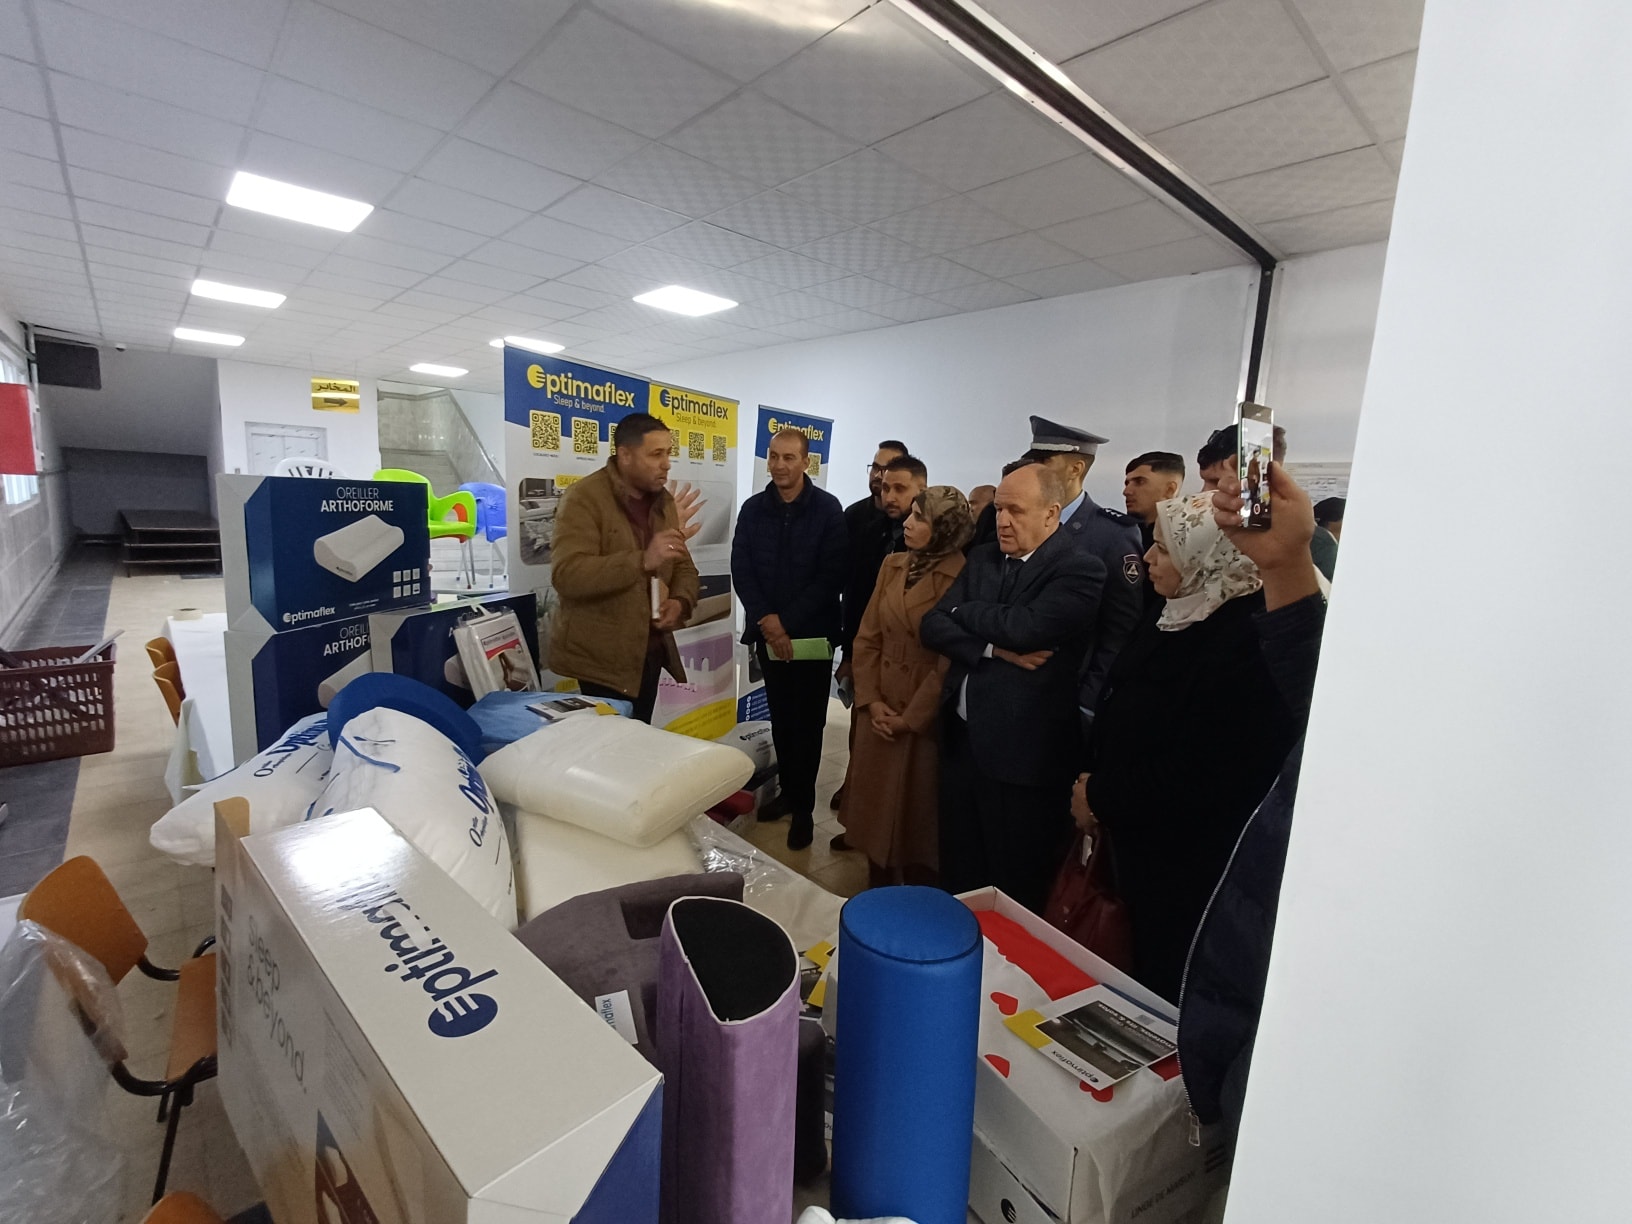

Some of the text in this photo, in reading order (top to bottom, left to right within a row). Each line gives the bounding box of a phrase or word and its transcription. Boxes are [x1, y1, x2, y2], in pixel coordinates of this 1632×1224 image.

[527, 364, 635, 408] Optimaflex
[554, 394, 573, 408] Sleep
[574, 398, 580, 409] &
[660, 389, 728, 420] Optimaflex
[676, 412, 691, 425] Sleep
[692, 417, 697, 425] &
[336, 486, 379, 500] OREILLER
[320, 499, 394, 512] ARTHOFORME
[282, 606, 336, 625] Optimaflex
[323, 634, 371, 657] ARTHOF
[1051, 1048, 1099, 1083] Optimaflex
